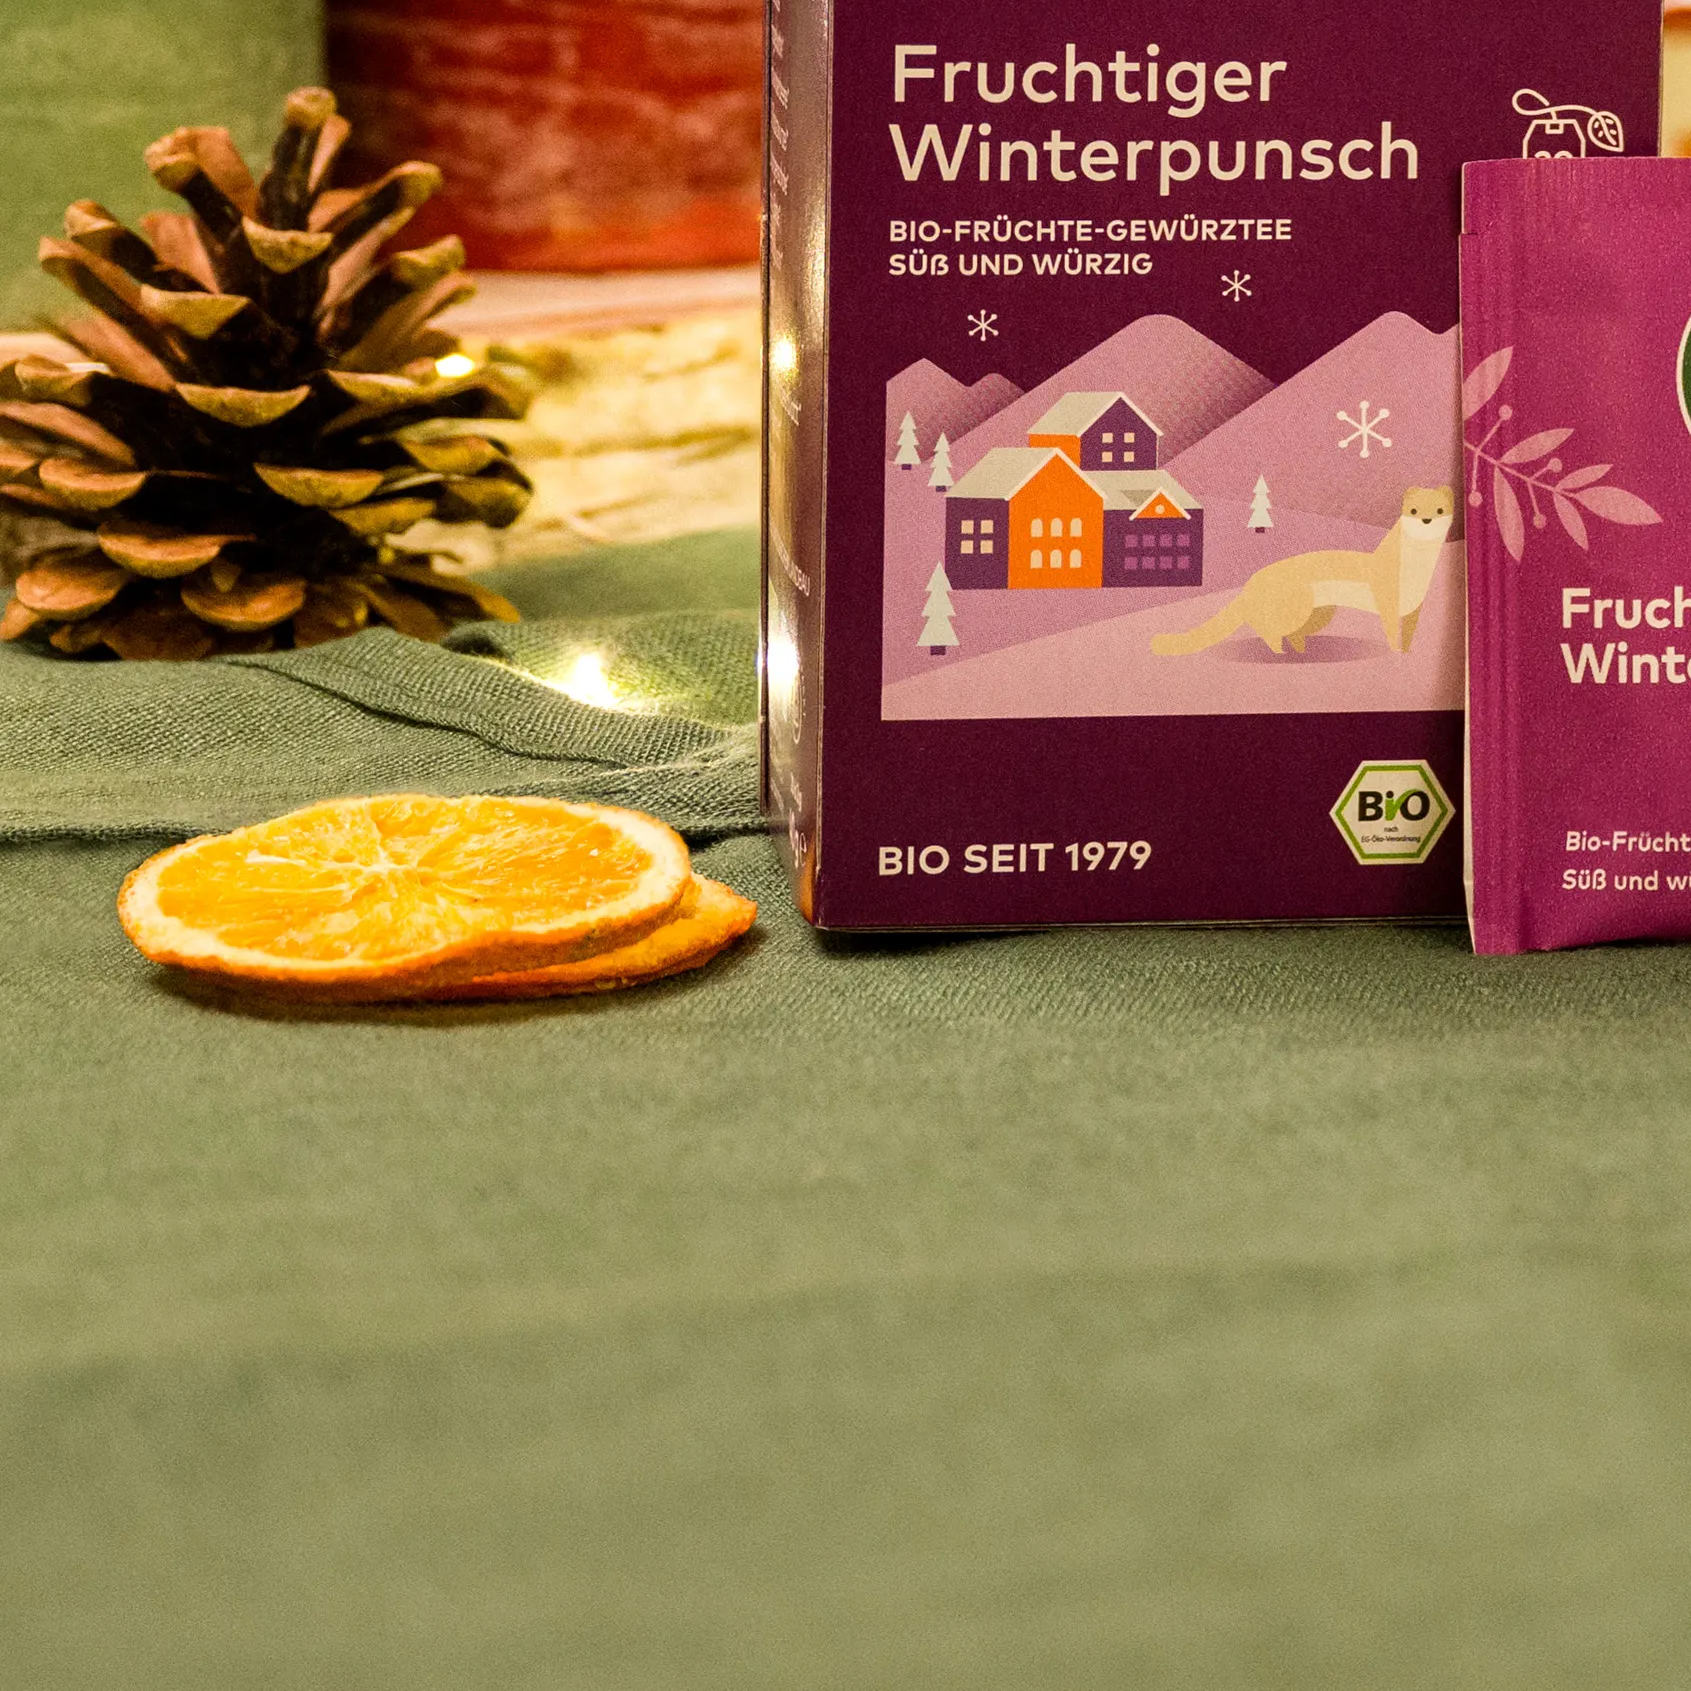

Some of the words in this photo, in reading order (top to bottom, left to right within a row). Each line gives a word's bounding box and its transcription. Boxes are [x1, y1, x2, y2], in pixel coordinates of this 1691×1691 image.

[894, 43, 1288, 119] Fruchtiger
[888, 120, 1418, 197] Winterpunsch
[889, 213, 1292, 243] BIO-FRÜCHTE-GEWÜRZTEE
[958, 253, 1024, 276] UND
[1031, 247, 1153, 276] WÜRZIG
[878, 844, 950, 876] BIO
[963, 842, 1054, 874] SEIT
[1064, 840, 1152, 872] 1979
[1562, 868, 1607, 890] Süß
[1614, 869, 1659, 891] und
